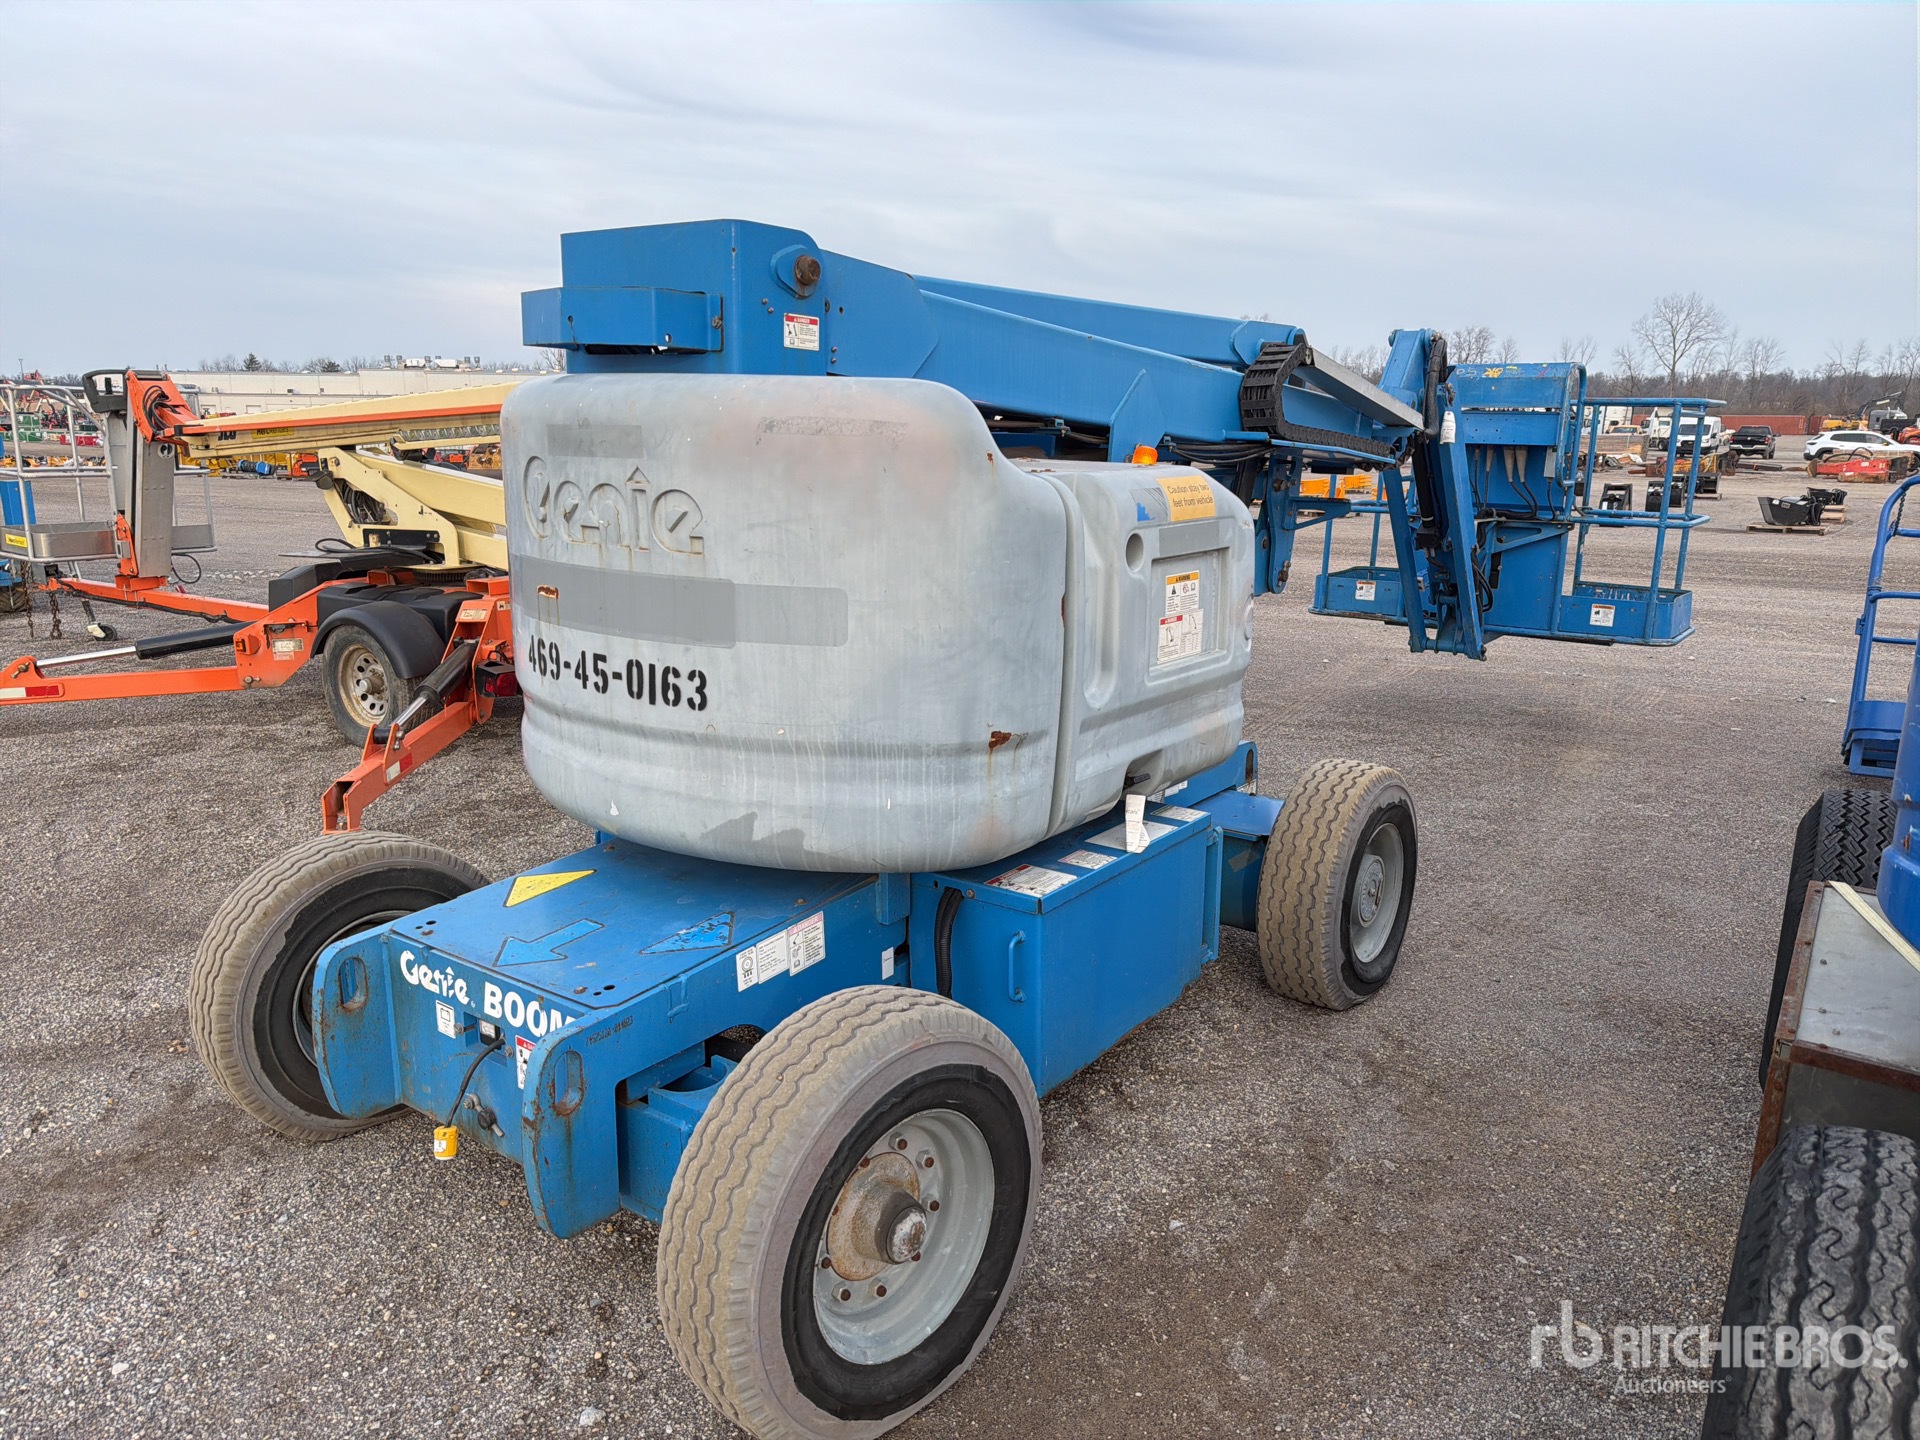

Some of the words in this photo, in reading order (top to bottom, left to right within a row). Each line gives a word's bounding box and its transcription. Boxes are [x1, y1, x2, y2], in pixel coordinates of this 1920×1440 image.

[523, 455, 704, 557] Genie
[1167, 485, 1188, 494] Caution
[1188, 485, 1200, 493] stay
[1173, 498, 1183, 507] feet
[1183, 497, 1196, 506] from
[1196, 495, 1214, 505] vehicle
[528, 634, 708, 712] 469-45-0163
